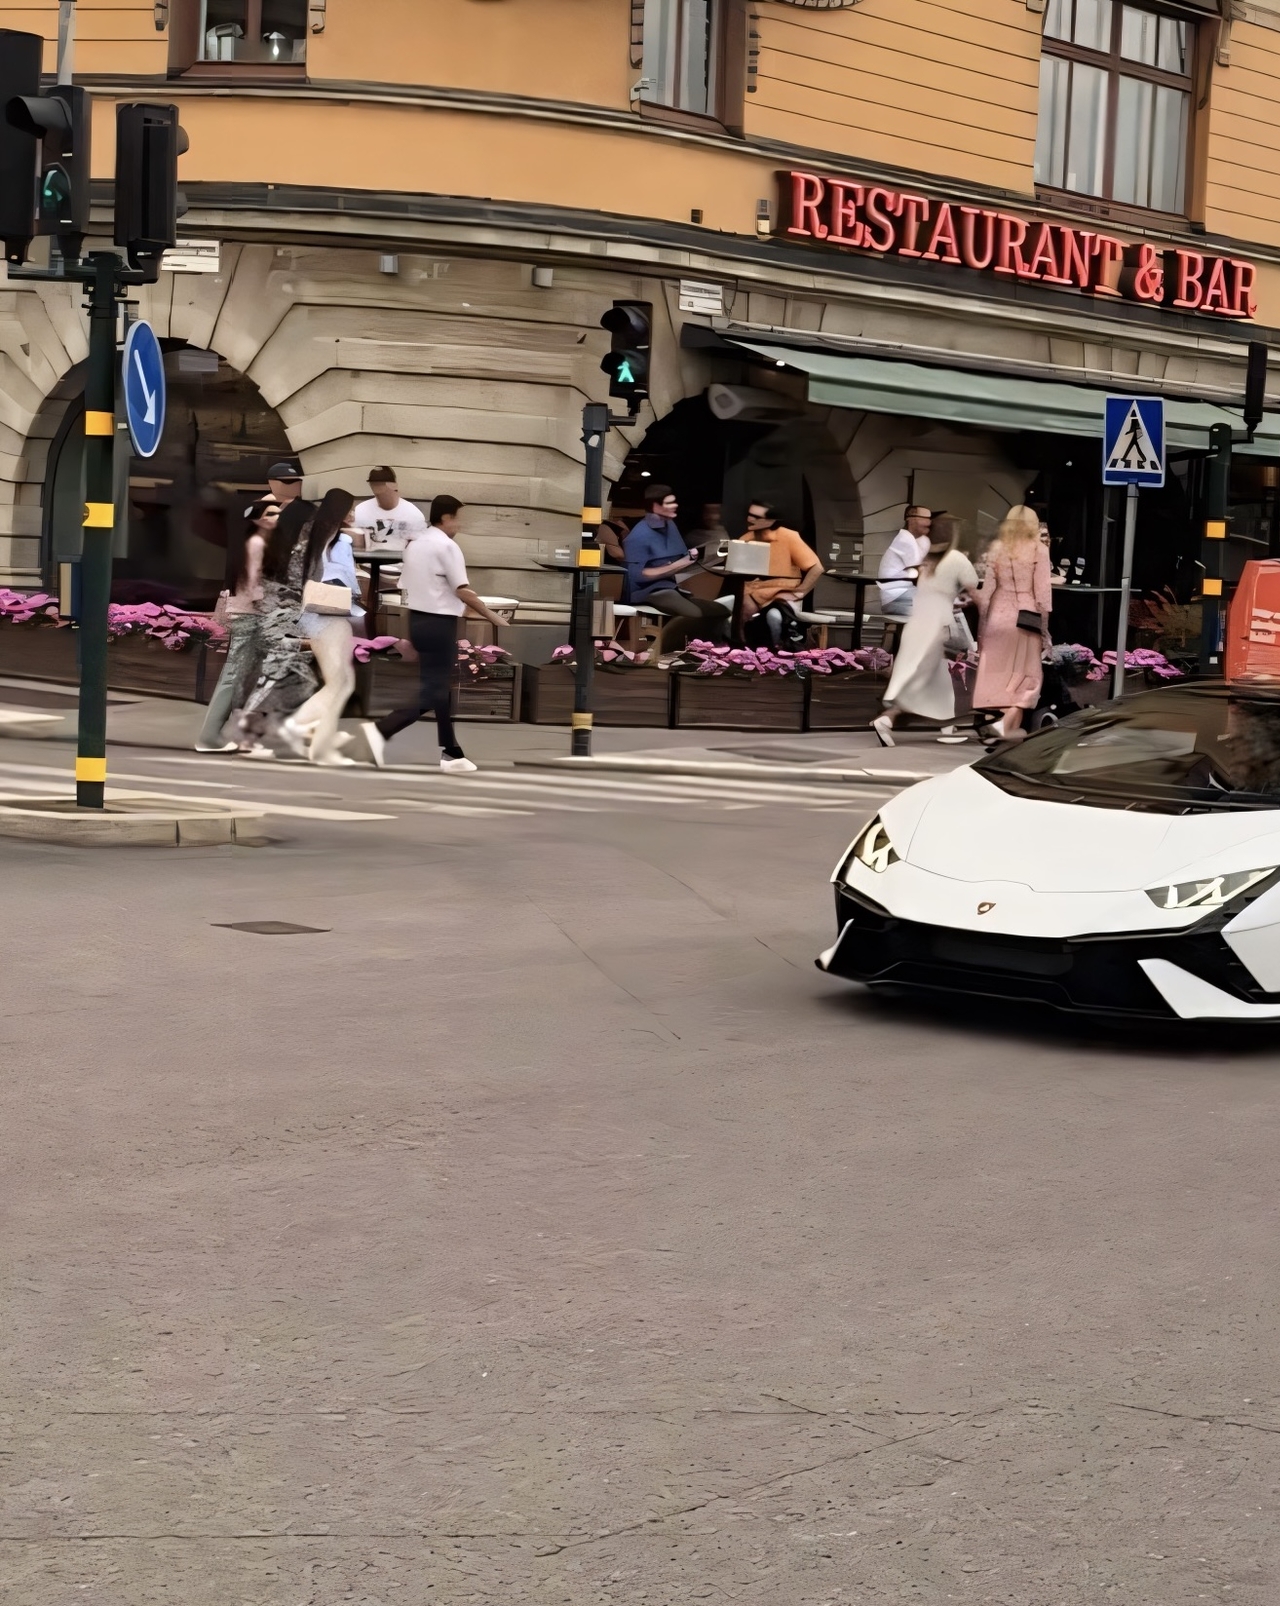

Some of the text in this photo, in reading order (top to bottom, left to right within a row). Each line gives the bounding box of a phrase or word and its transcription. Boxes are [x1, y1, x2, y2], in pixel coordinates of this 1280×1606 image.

[788, 171, 1257, 315] RESTAURANT & BAR
